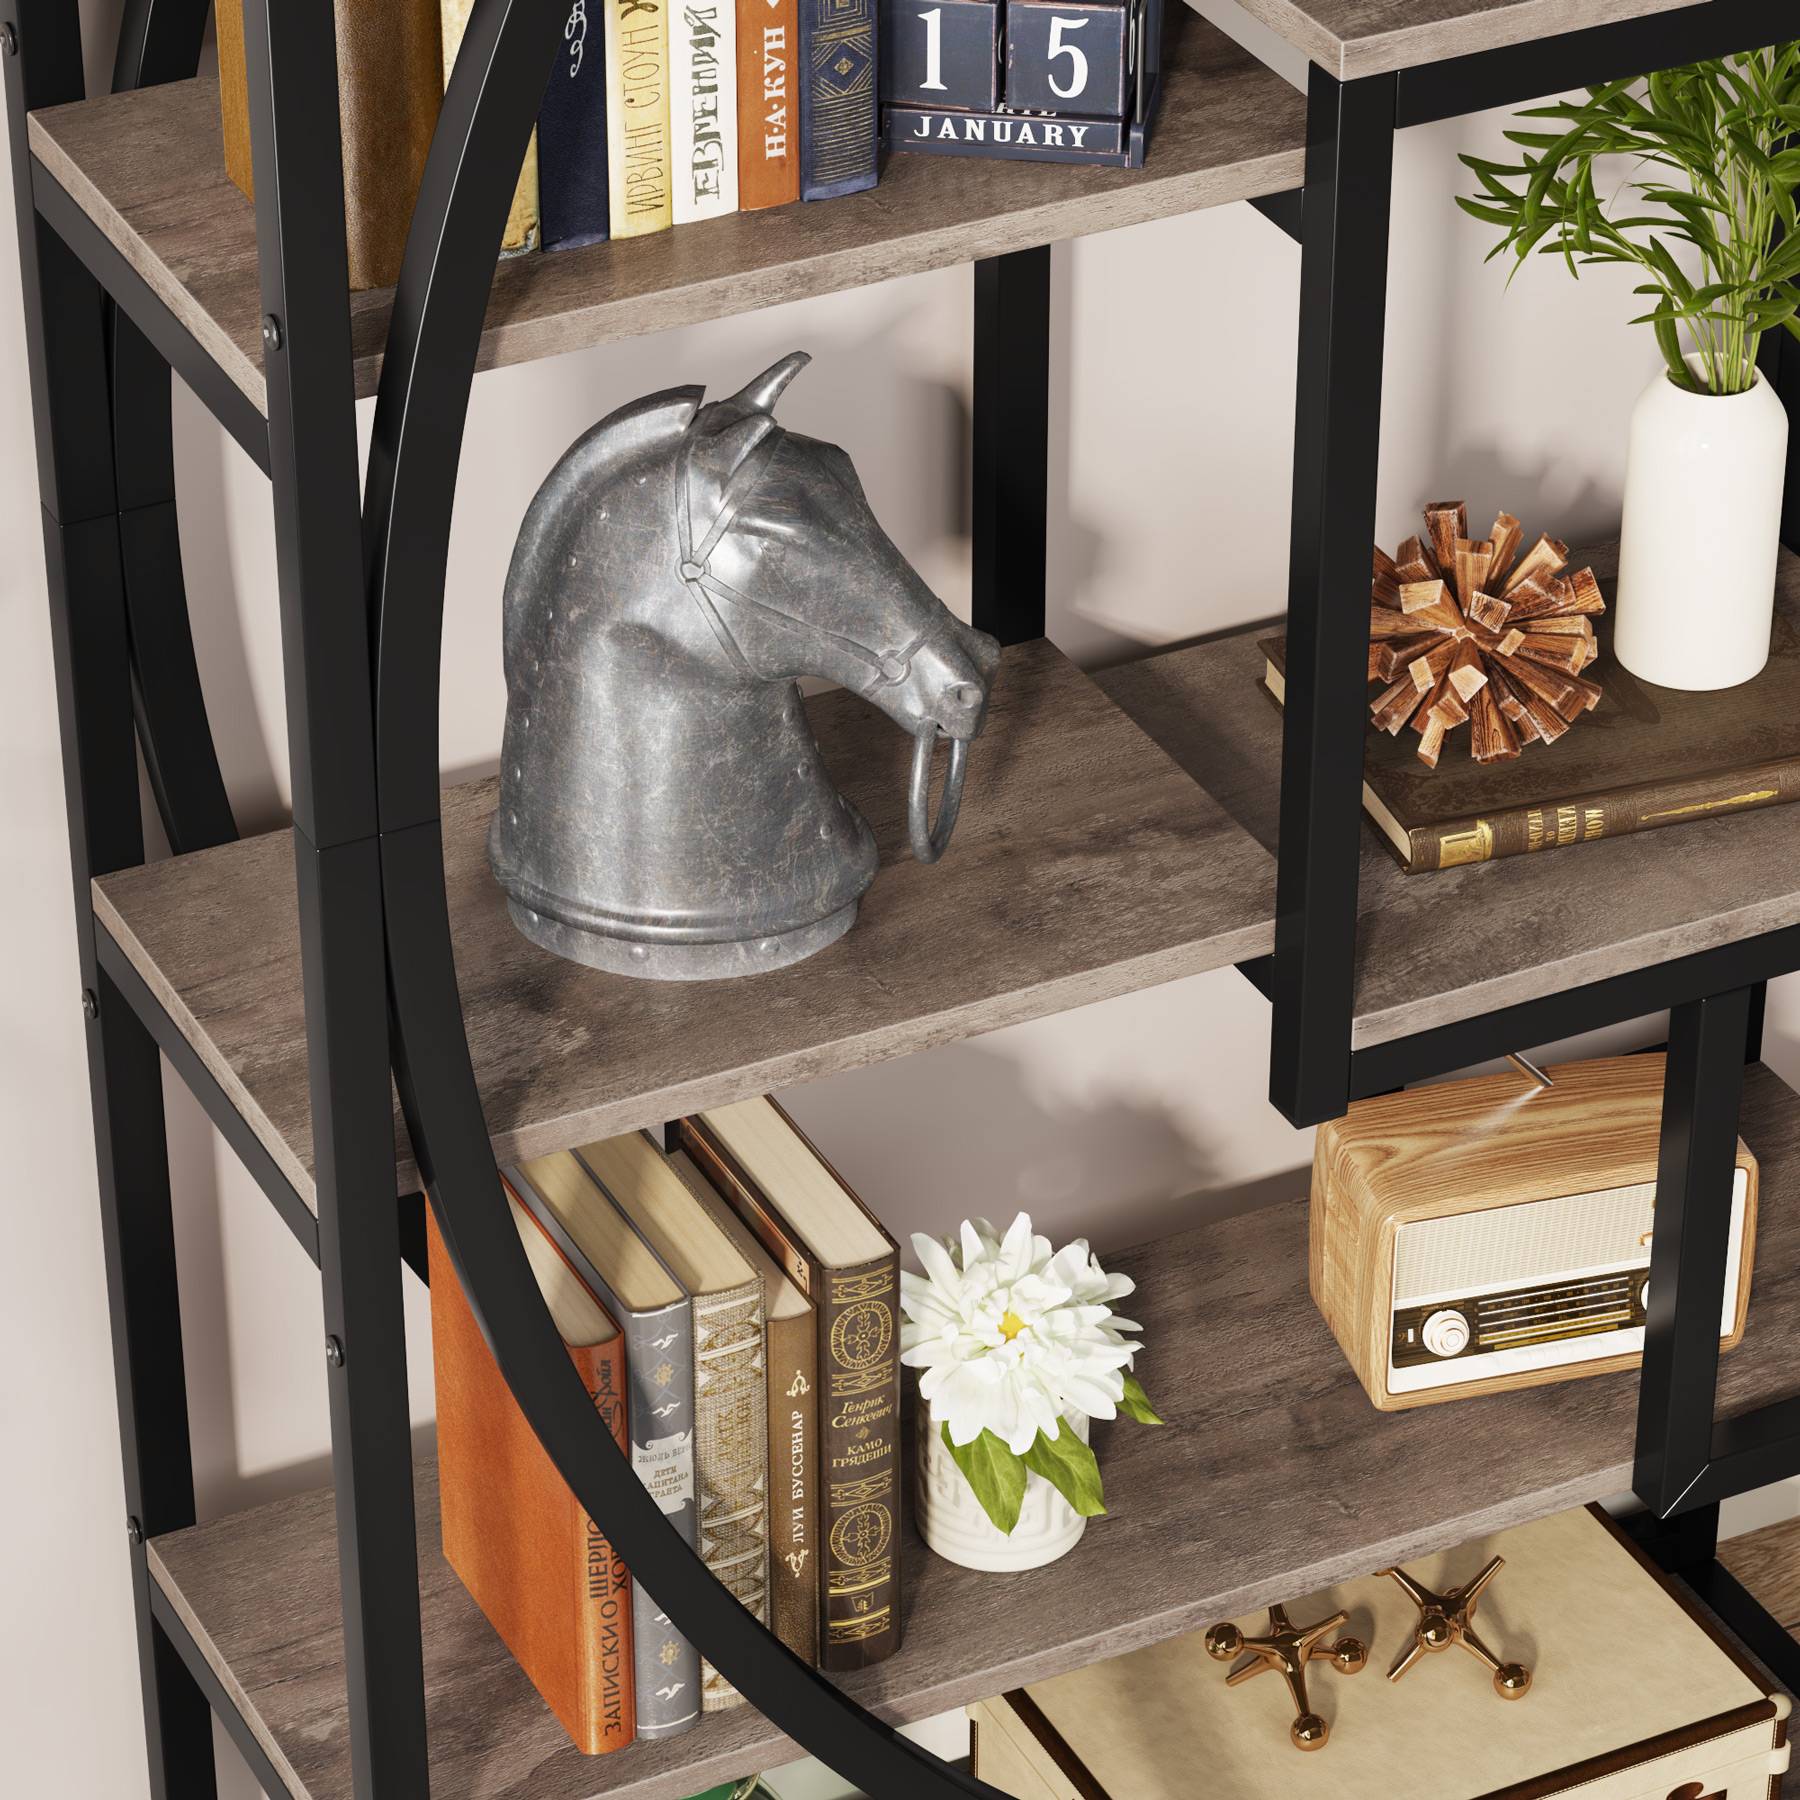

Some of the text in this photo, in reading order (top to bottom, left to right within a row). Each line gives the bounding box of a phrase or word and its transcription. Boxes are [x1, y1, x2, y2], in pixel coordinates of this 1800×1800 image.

[621, 24, 661, 109] СТОУН
[1047, 16, 1090, 99] 5
[683, 4, 725, 206] ЕВГЕНИЙ
[913, 115, 1090, 149] JANUARY
[624, 122, 666, 215] ИРВИНГ
[841, 1393, 888, 1415] Генрик
[644, 1471, 689, 1490] АПИТАНА
[791, 1410, 805, 1543] ЛУИ БУССЕНАР
[847, 1437, 884, 1456] КАМО
[602, 1623, 621, 1736] ЗАПИСКИ
